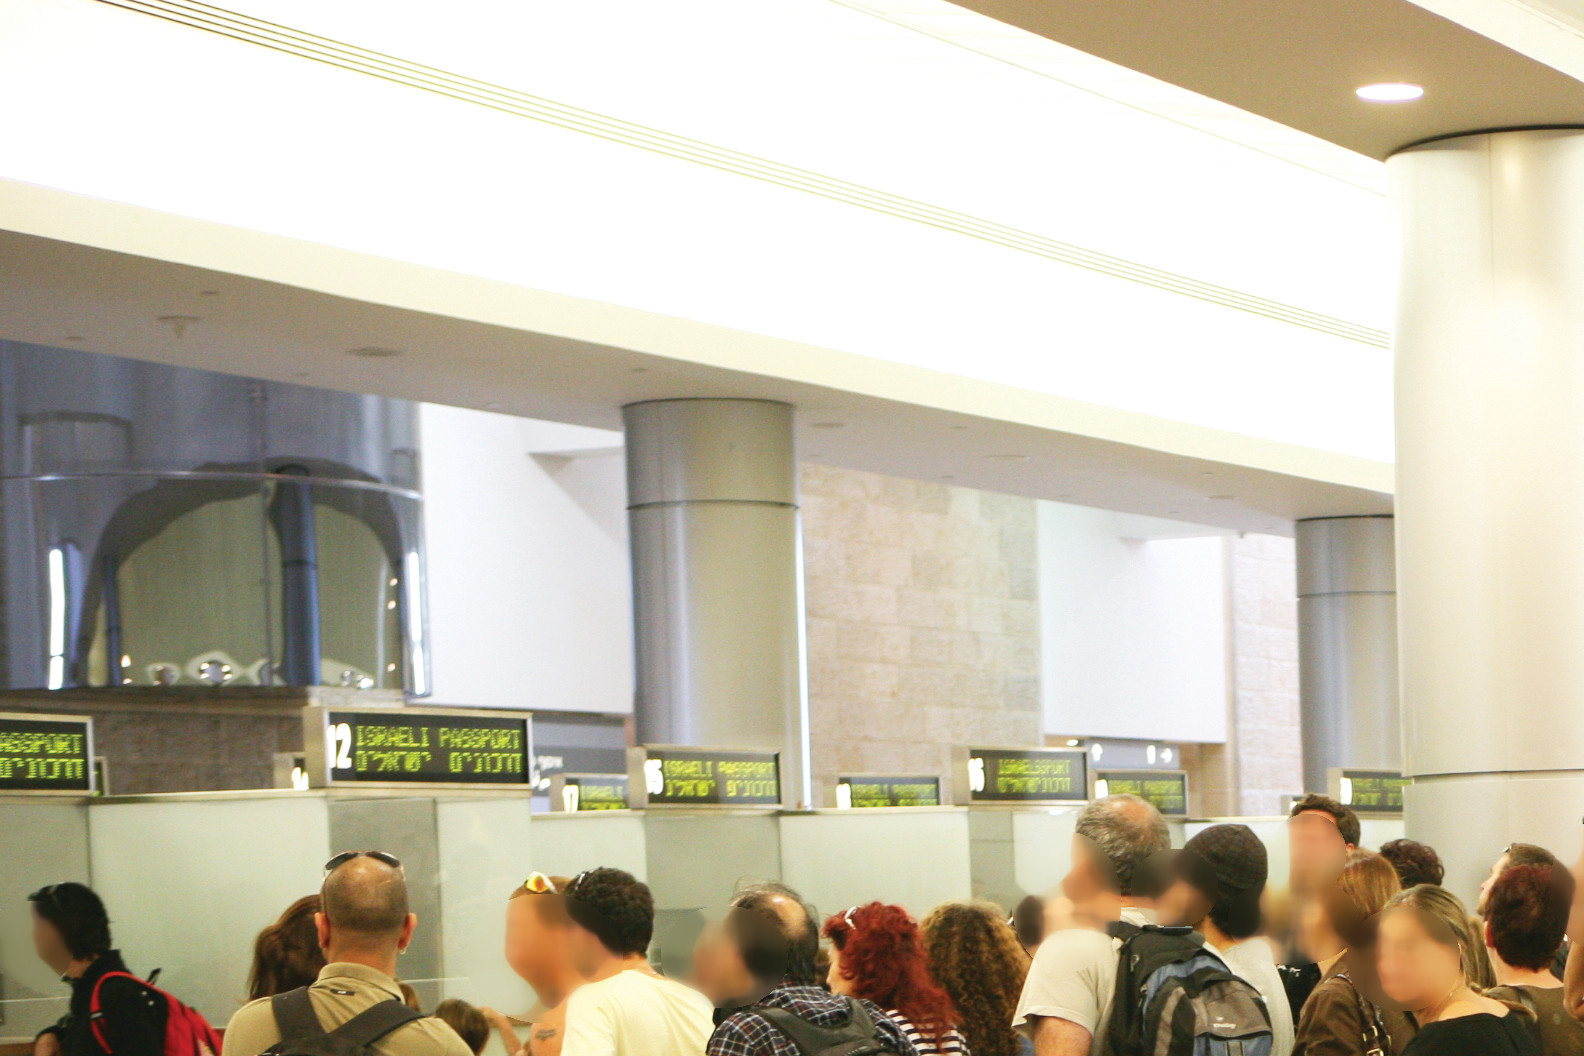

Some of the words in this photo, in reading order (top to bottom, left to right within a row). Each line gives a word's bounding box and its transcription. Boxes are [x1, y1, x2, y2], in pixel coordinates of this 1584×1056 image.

[326, 723, 352, 769] 12
[356, 726, 429, 748] ISRAELI
[438, 728, 521, 749] PASSPORT
